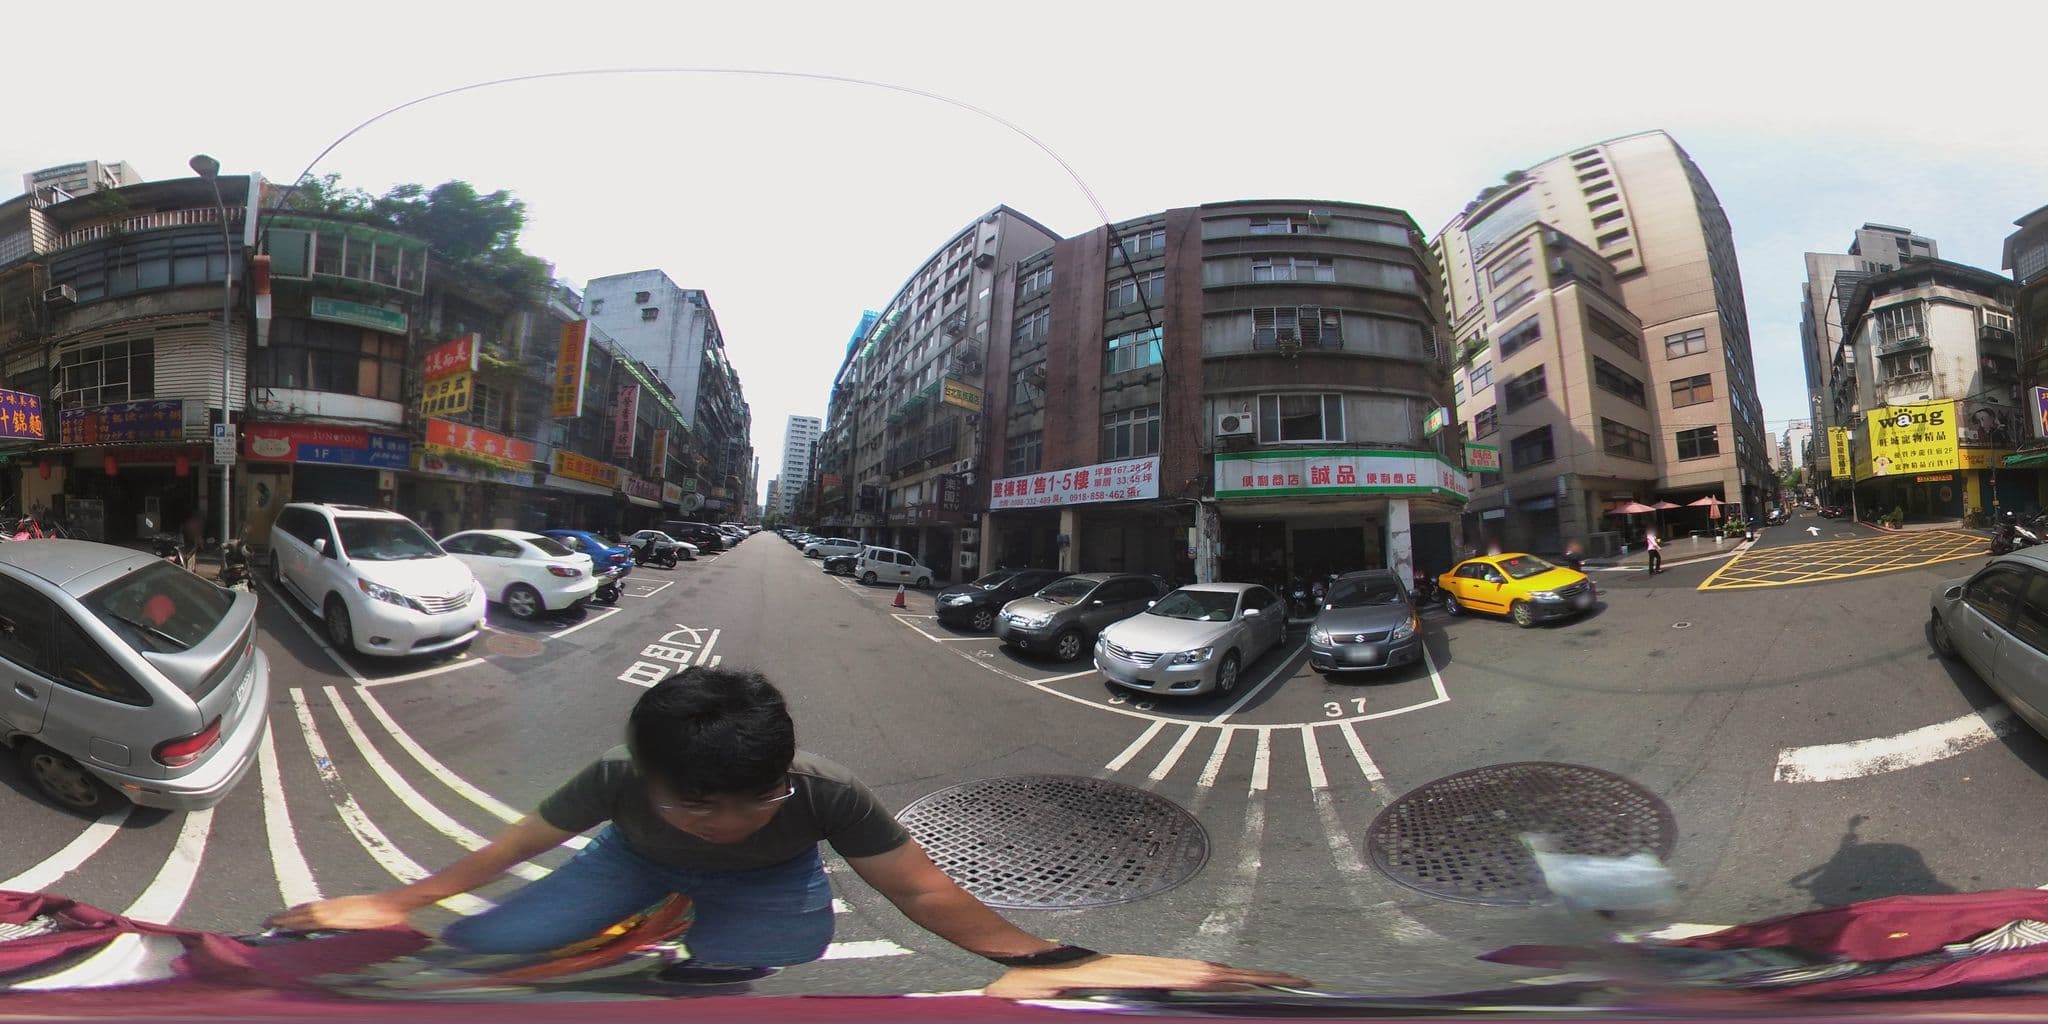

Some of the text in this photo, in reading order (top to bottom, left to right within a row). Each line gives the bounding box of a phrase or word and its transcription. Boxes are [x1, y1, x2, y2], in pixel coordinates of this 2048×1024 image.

[1241, 465, 1417, 488] 便利商店 誠品 便利商店
[1324, 697, 1367, 717] 37
